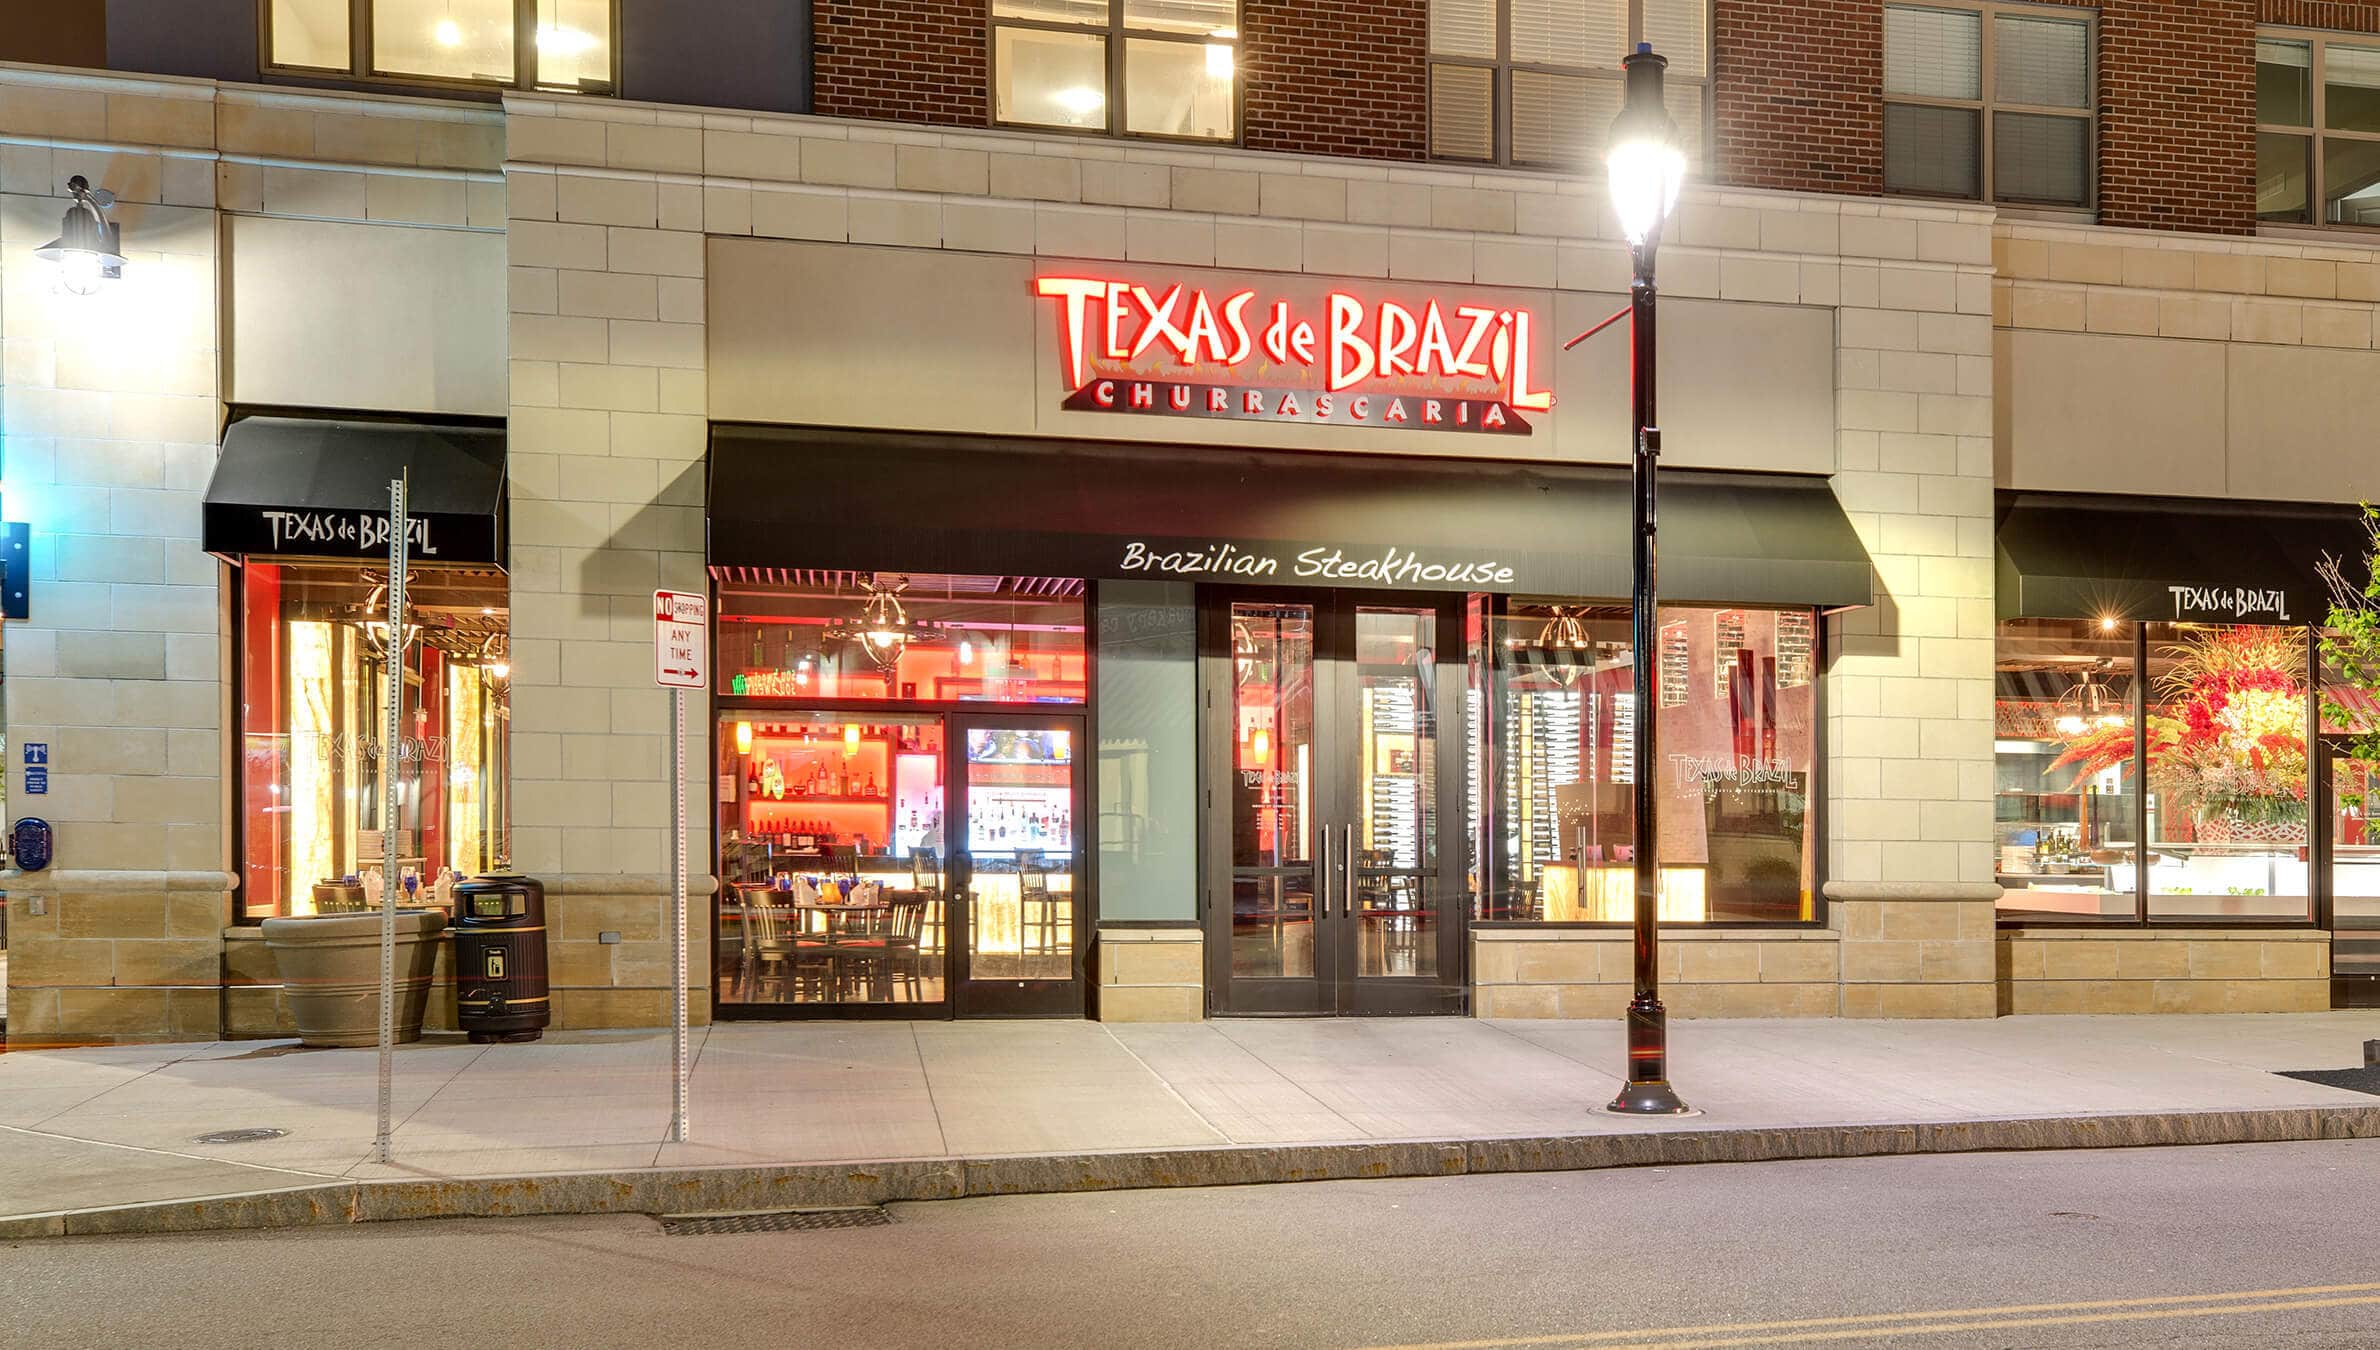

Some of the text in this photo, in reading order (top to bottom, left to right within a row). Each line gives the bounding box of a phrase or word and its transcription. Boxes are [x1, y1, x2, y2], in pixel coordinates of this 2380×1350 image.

[1035, 277, 1255, 390] TEXAS
[1262, 301, 1315, 366] de
[1095, 382, 1506, 427] CHURRASCARIA
[262, 511, 437, 554] TEXAS de BRZIL
[1120, 542, 1515, 585] Brazilian Steakhouse
[657, 597, 672, 615] NO
[2168, 586, 2220, 619] TEXAS
[2220, 590, 2233, 610] de
[671, 629, 691, 643] ANY
[670, 647, 692, 661] TIME
[1668, 754, 1724, 789] TEXAS
